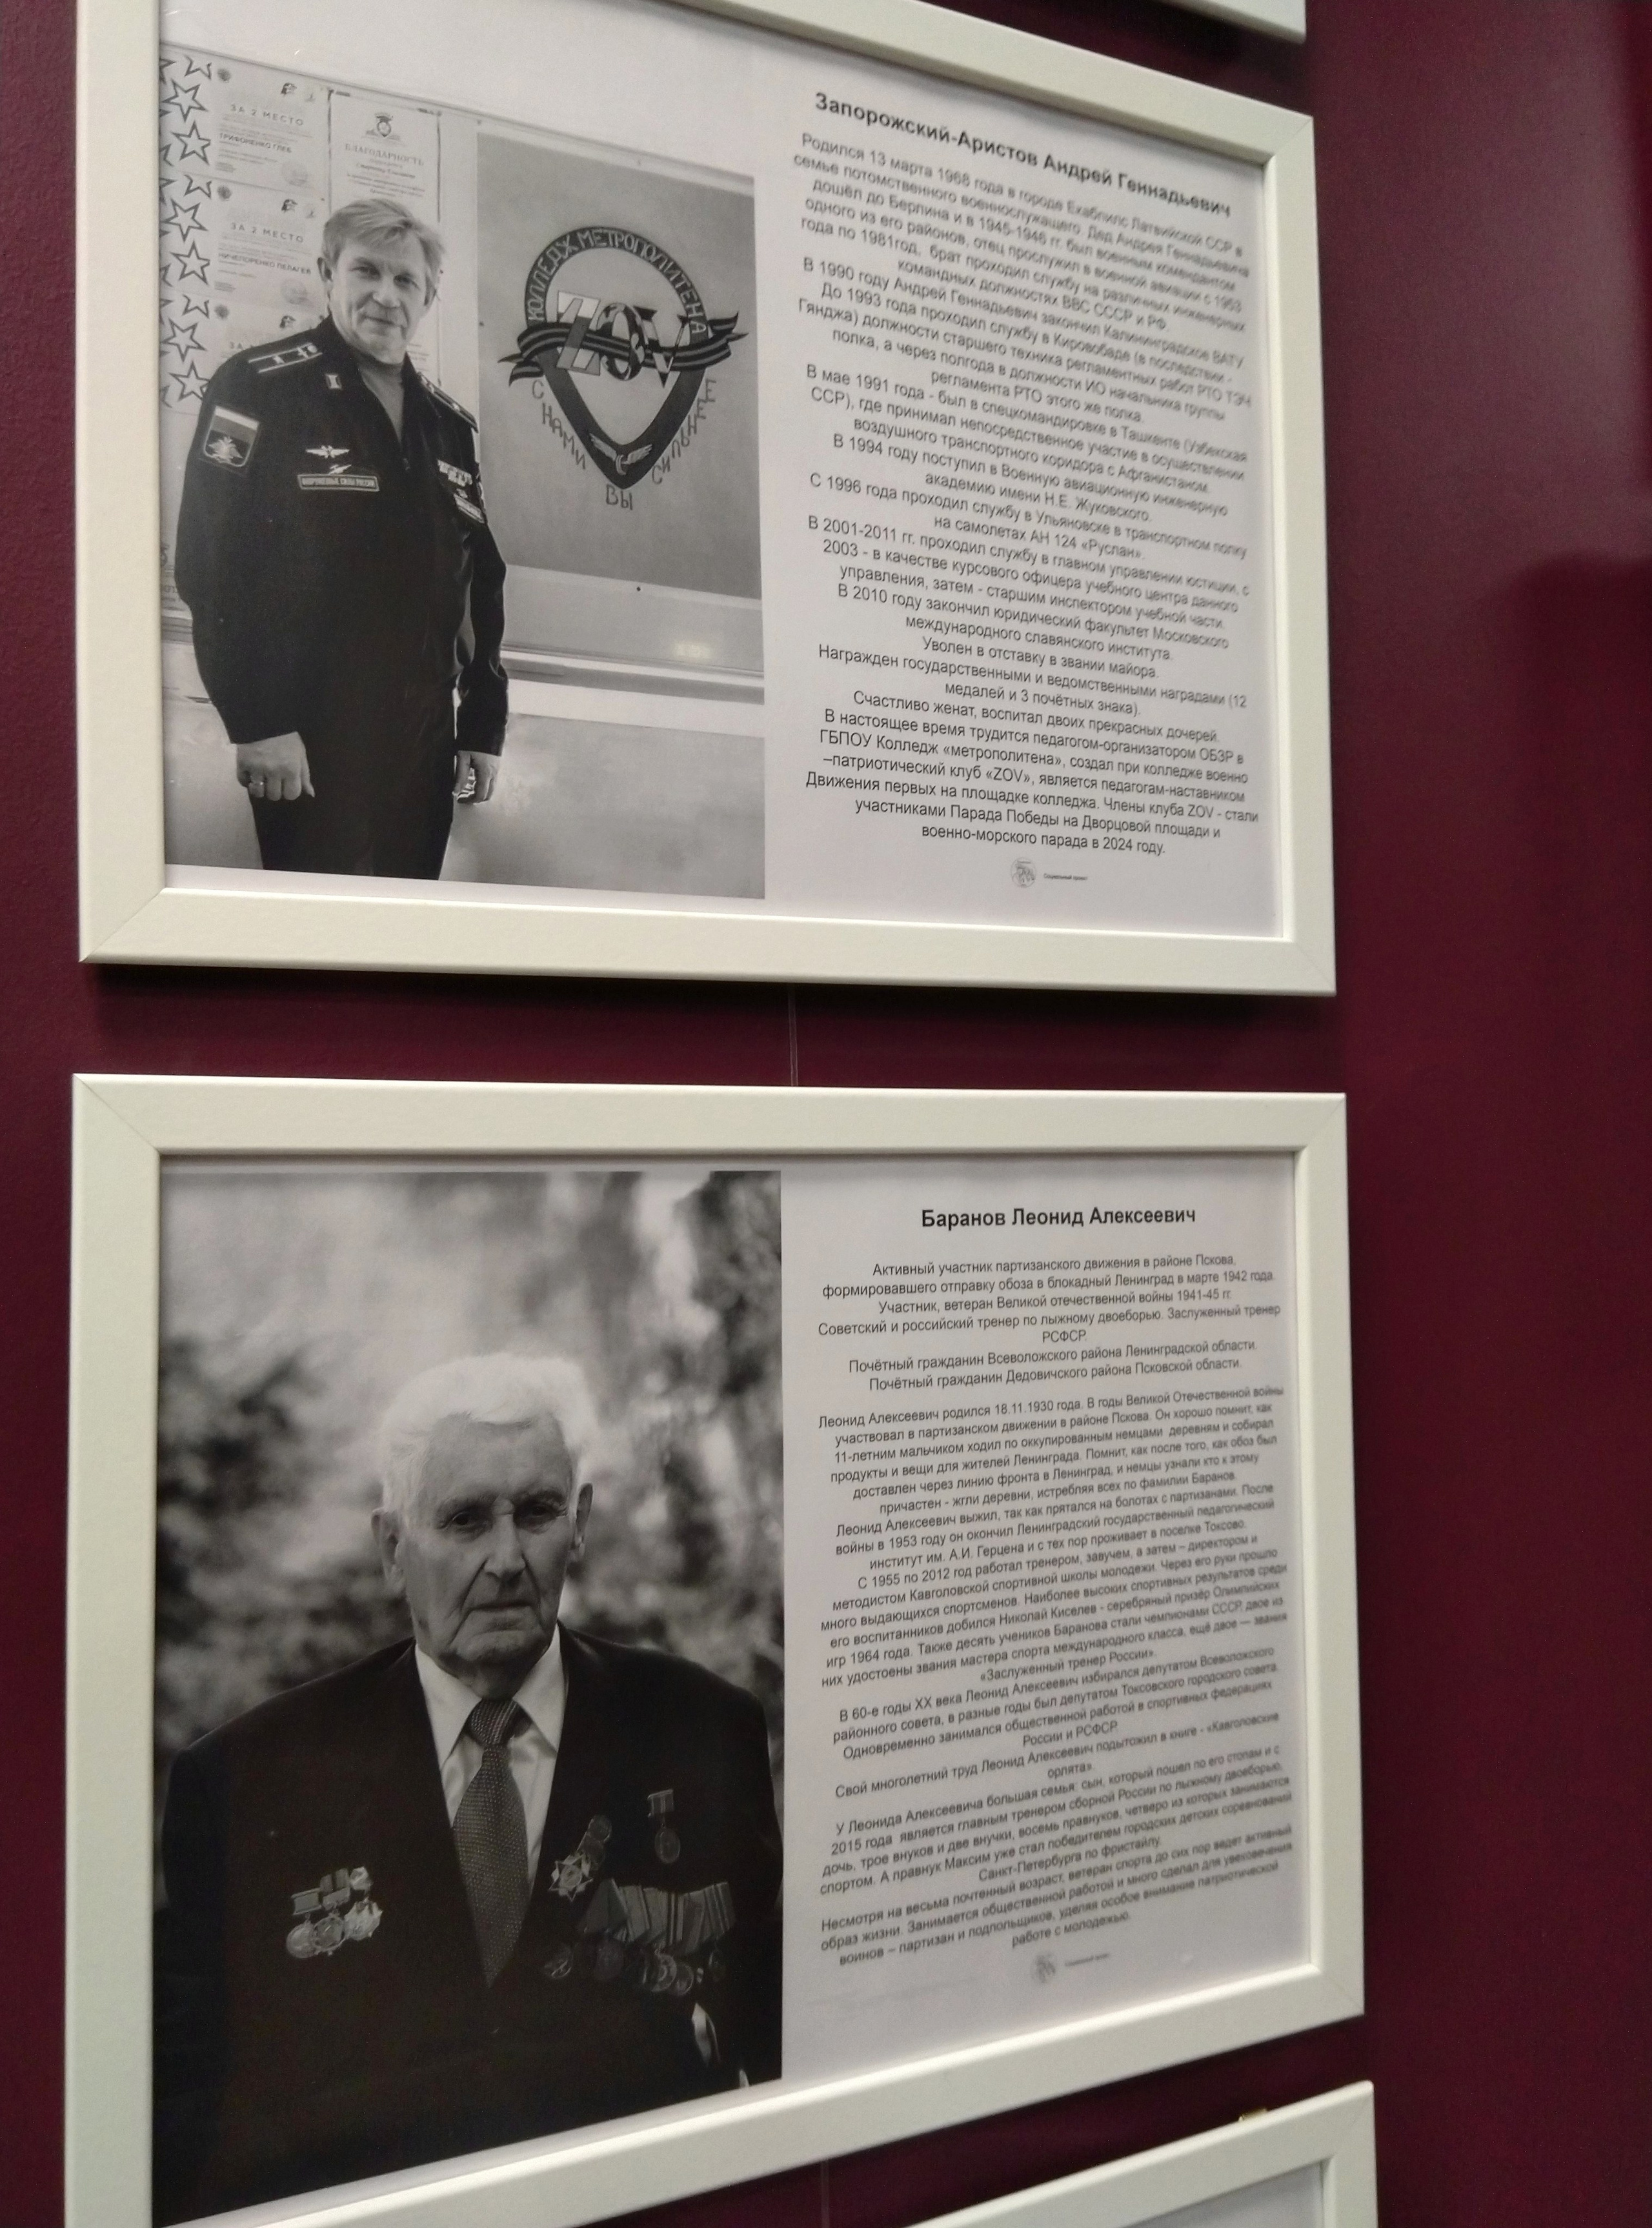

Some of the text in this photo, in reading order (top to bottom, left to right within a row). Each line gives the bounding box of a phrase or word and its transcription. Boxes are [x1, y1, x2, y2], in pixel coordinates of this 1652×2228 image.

[263, 112, 305, 126] МЕСТО
[816, 92, 1230, 217] Запорожский-Аристов Андрей Геннадьевич
[263, 229, 304, 243] МЕСТО
[527, 228, 707, 334] КОЛЛЕДЖ МЕТРОПОЛИТЕНА
[556, 290, 694, 388] ZOV
[542, 403, 586, 470] НАМИ
[605, 484, 633, 510] ВЫ
[652, 378, 716, 485] СИЛЬНЕЕ
[925, 473, 996, 496] академию
[999, 487, 1041, 503] имени
[934, 517, 951, 529] на
[955, 519, 1026, 541] самолетах
[1030, 529, 1049, 545] АН
[1054, 534, 1077, 549] 124
[906, 616, 1021, 641] международного
[1025, 632, 1104, 652] славянского
[922, 636, 1158, 679] Уволен в отставку в звании майора.
[819, 644, 1247, 708] Награжден государственными и ведомственными наградами (12
[853, 690, 929, 712] Счастливо
[933, 702, 977, 719] женат,
[982, 708, 1043, 724] воспитал
[1046, 715, 1085, 728] двоих
[1089, 719, 1163, 736] прекрасных
[945, 683, 1140, 718] медалей и 3 почётных знака).
[825, 708, 1244, 765] В настоящее время трудится педагогом-организатором ОБЗР в
[820, 728, 1248, 784] ГБПОУ Колледж «метрополитена», создал при колледже военно
[805, 771, 880, 791] Движения
[885, 781, 936, 796] первых
[941, 786, 957, 798] на
[962, 787, 1029, 805] площадке
[1033, 794, 1100, 810] колледжа.
[1103, 797, 1145, 813] Члены
[1149, 803, 1184, 818] клуба
[1187, 803, 1214, 818] ZOV
[1225, 810, 1258, 822] стали
[950, 765, 982, 781] клуб
[985, 767, 1034, 785] «ZOV»,
[1039, 774, 1098, 789] является
[1102, 779, 1245, 802] педагогам-наставником
[855, 799, 1220, 839] участниками Парада Победы на Дворцовой площади и
[922, 826, 1165, 856] военно-морского парада в 2024 году.
[922, 1207, 1195, 1230] Баранов Леонид Алексеевич
[872, 1262, 934, 1276] Активный
[938, 1263, 992, 1276] участник
[996, 1260, 1081, 1274] партизанского
[1083, 1258, 1140, 1271] движения
[1143, 1258, 1150, 1267] в
[1153, 1255, 1193, 1269] районе
[823, 1283, 937, 1300] формировавшего
[940, 1281, 995, 1294] отправку
[998, 1277, 1033, 1290] обоза
[1037, 1280, 1044, 1289] в
[1047, 1274, 1111, 1289] блокадный
[1114, 1274, 1174, 1287] Ленинград
[1177, 1274, 1184, 1284] в
[1187, 1273, 1219, 1285] марте
[1223, 1270, 1247, 1282] 1942
[878, 1301, 940, 1314] Участник,
[944, 1300, 993, 1312] ветеран
[997, 1294, 1047, 1309] Великой
[1050, 1291, 1136, 1307] отечественной
[1138, 1290, 1173, 1303] войны
[1178, 1288, 1220, 1301] 1941-45
[818, 1320, 887, 1336] Советский
[891, 1323, 898, 1332] и
[902, 1316, 973, 1334] российский
[977, 1317, 1020, 1330] тренер
[1023, 1316, 1038, 1326] по
[1040, 1314, 1094, 1325] лыжному
[1167, 1304, 1241, 1320] Заслуженный
[1244, 1305, 1281, 1318] тренер
[849, 1357, 914, 1373] Почётный
[918, 1356, 984, 1371] гражданин
[987, 1350, 1078, 1365] Всеволожского
[1081, 1347, 1122, 1362] района
[1125, 1341, 1209, 1358] Ленинградской
[869, 1374, 933, 1390] Почётный
[937, 1373, 1003, 1389] гражданин
[1005, 1368, 1088, 1385] Дедовичского
[1091, 1364, 1132, 1380] района
[1135, 1359, 1193, 1374] Псковской
[1067, 1654, 1106, 1671] тренер
